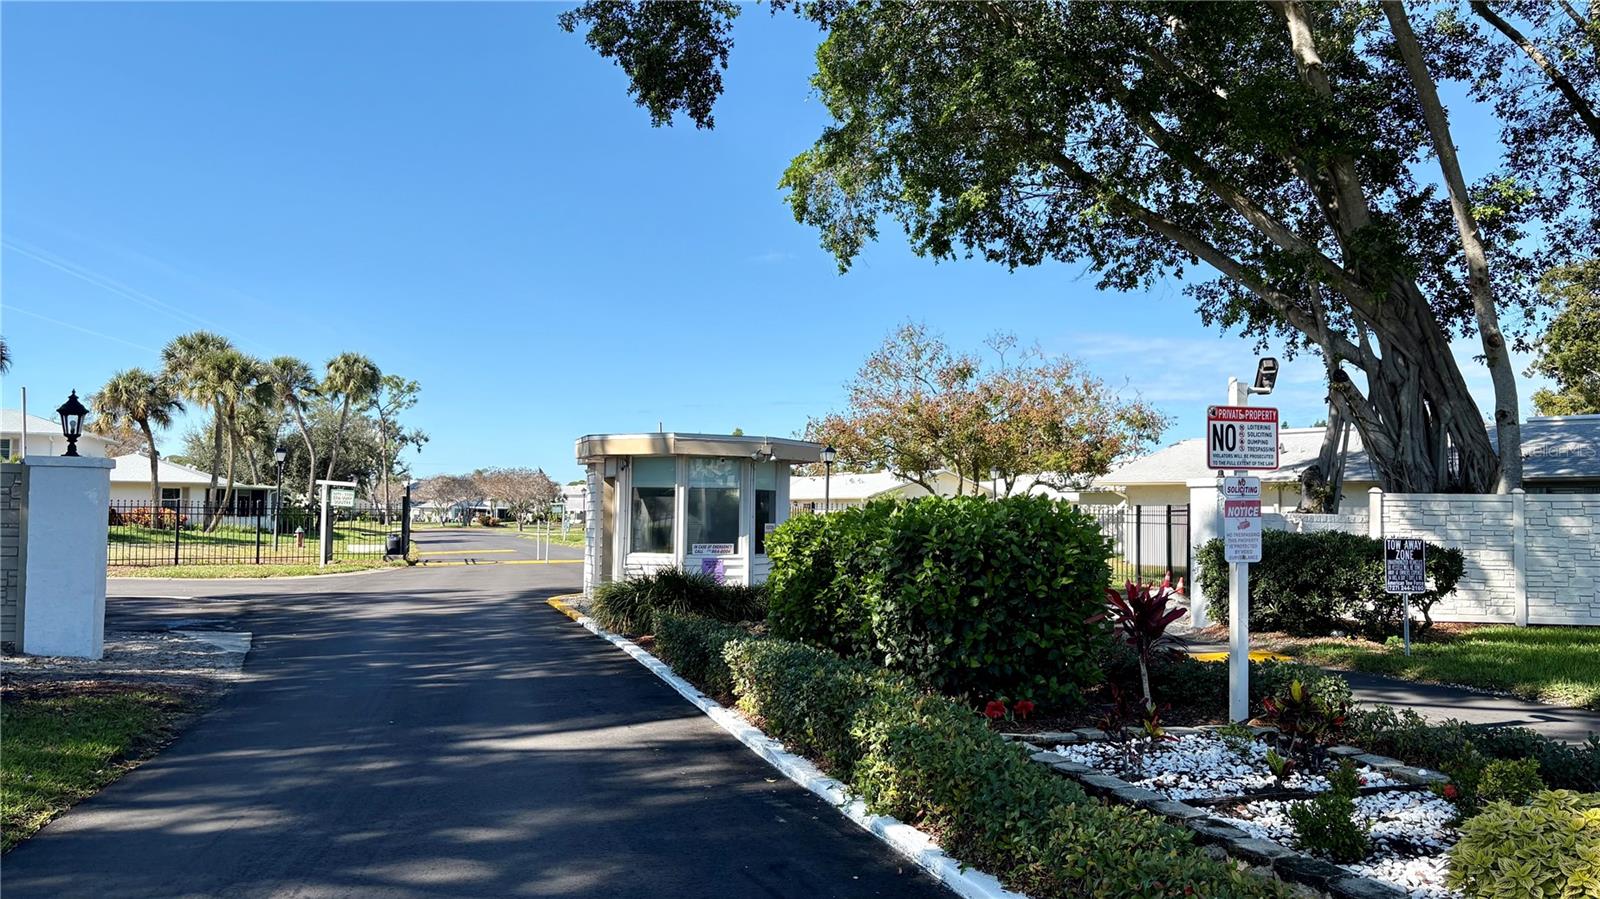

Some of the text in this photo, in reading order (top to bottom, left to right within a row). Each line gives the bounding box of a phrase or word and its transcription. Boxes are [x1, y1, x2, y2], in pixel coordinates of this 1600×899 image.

[1218, 409, 1277, 420] PRIVATE PROPERTY
[1212, 424, 1237, 451] NO
[1227, 506, 1259, 517] NOTICE
[1387, 540, 1422, 550] TOW AWAY
[1396, 550, 1414, 560] ZONE
